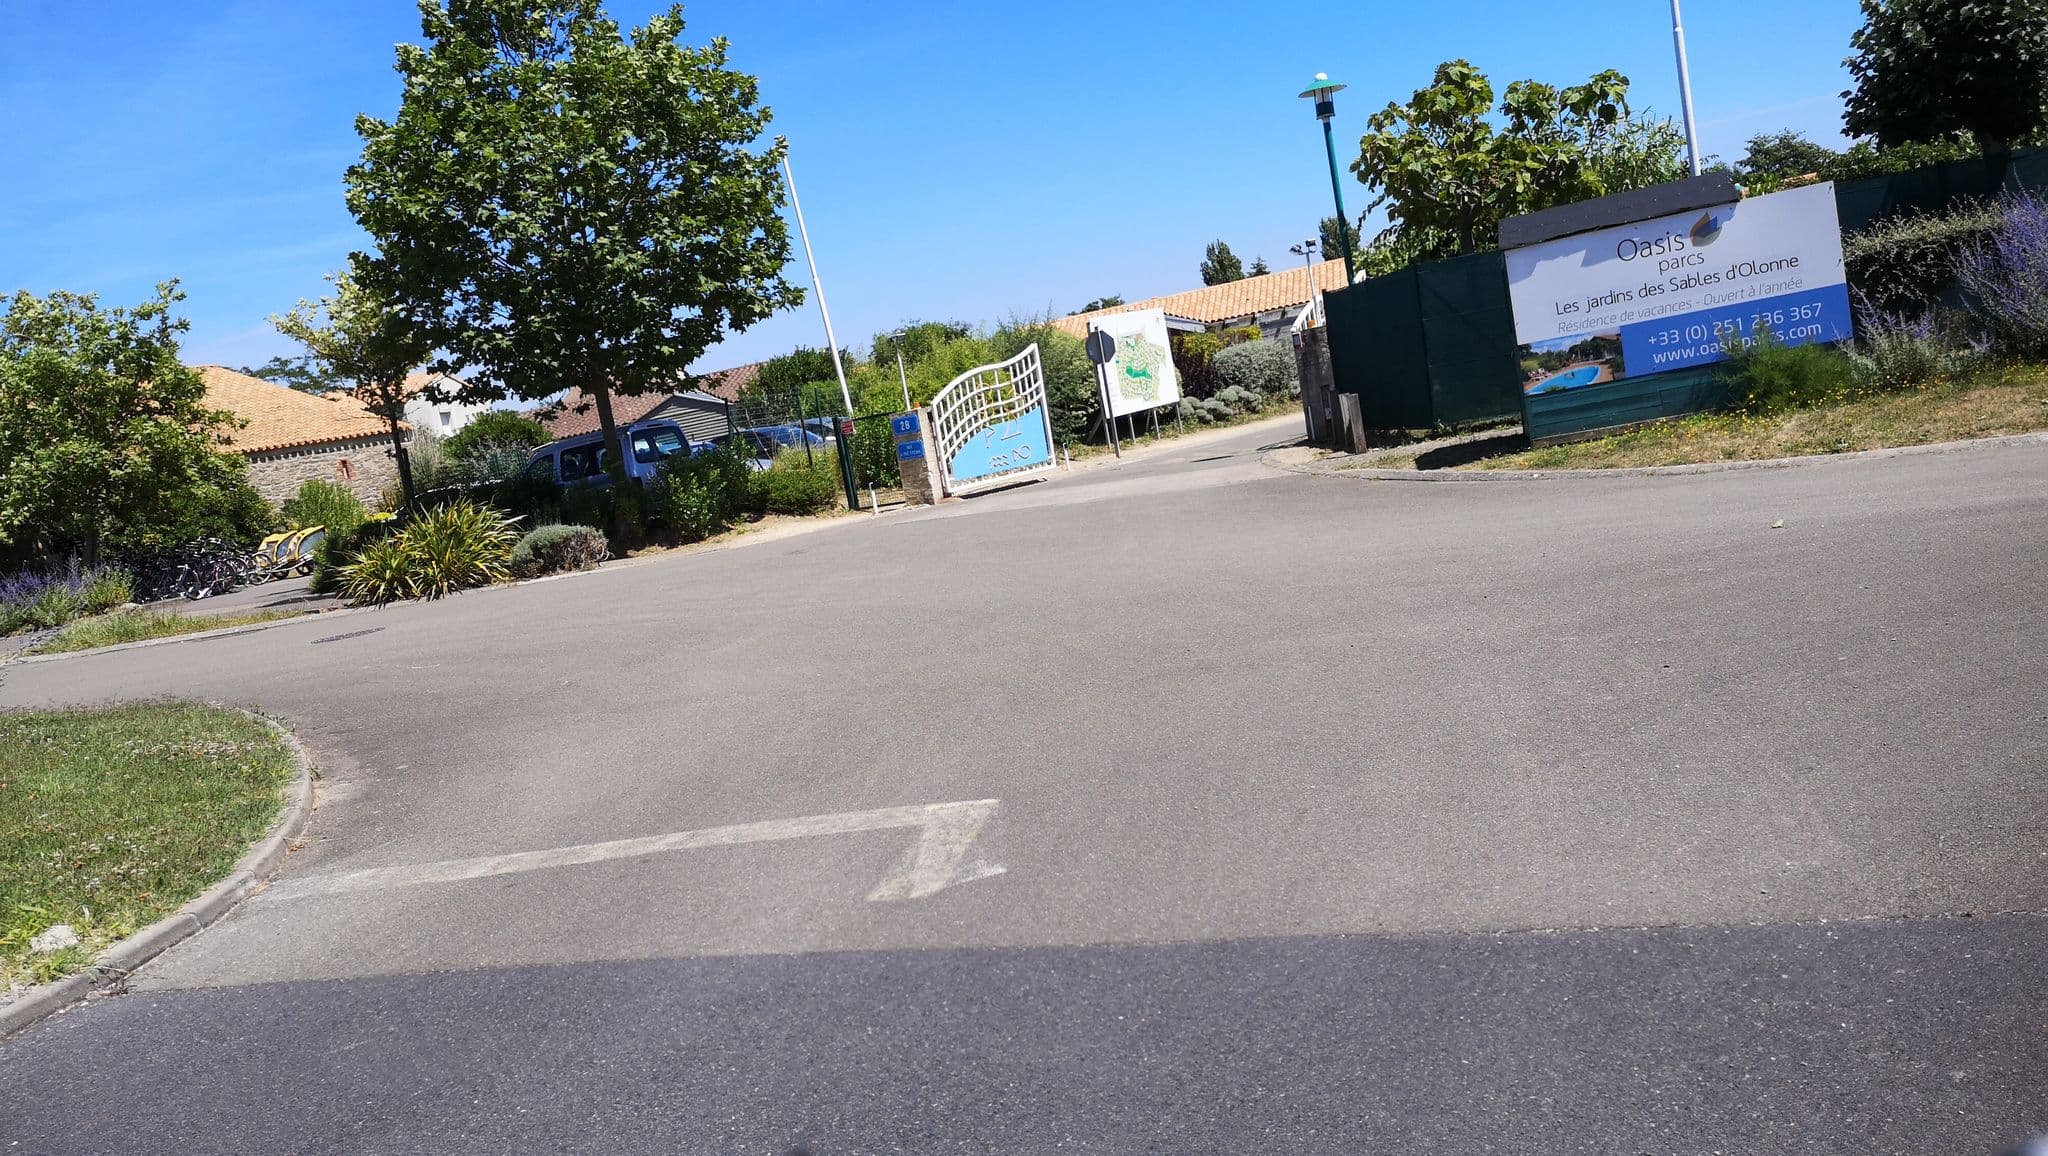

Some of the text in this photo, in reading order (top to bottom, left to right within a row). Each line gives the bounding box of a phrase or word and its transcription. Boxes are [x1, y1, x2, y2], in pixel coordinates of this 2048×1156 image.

[1617, 231, 1685, 262] Oasis
[1658, 252, 1705, 276] parcs
[1555, 256, 1800, 316] Les jardins des Sables d'Olonne
[1558, 313, 1617, 334] Résidence
[1620, 309, 1635, 322] de
[1637, 299, 1693, 319] vacances
[1703, 287, 1745, 306] Ouvert
[1748, 285, 1756, 298] à
[1759, 277, 1803, 296] l'année
[1648, 302, 1822, 346] +33 (0) 251 236 367
[1653, 323, 1822, 364] www.oasispas.com
[899, 420, 911, 431] 28
